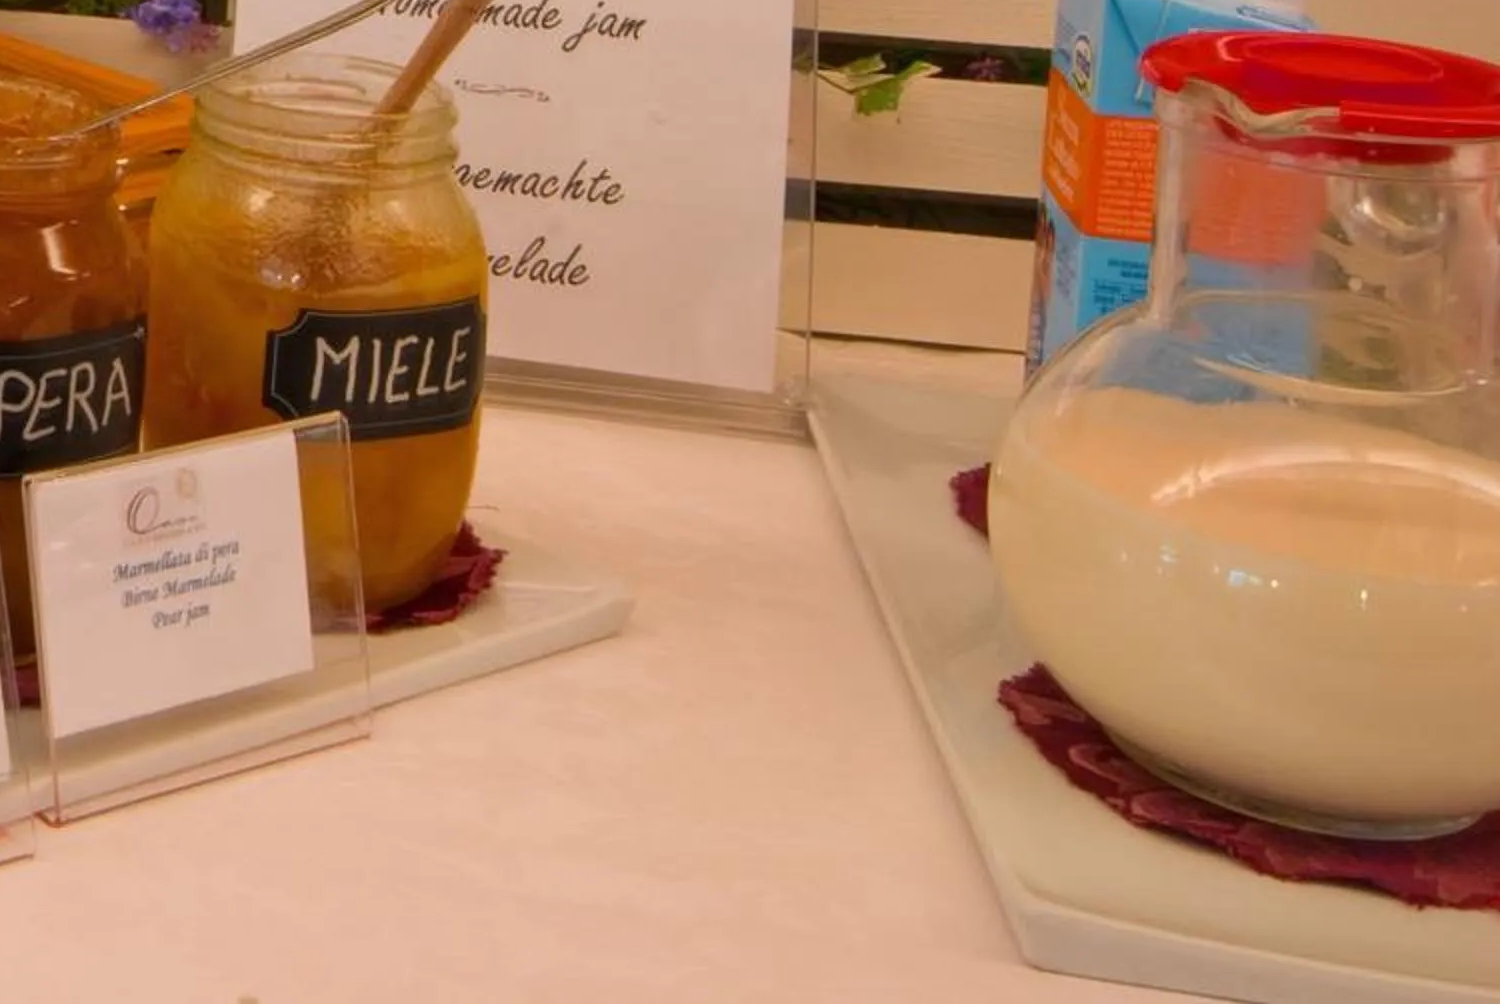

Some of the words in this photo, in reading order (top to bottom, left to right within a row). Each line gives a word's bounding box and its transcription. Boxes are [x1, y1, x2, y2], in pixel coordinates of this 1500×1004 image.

[561, 0, 647, 53] jam
[486, 235, 590, 285] elade
[310, 326, 472, 403] MIELE
[152, 608, 183, 629] Pear
[184, 601, 210, 628] jam
